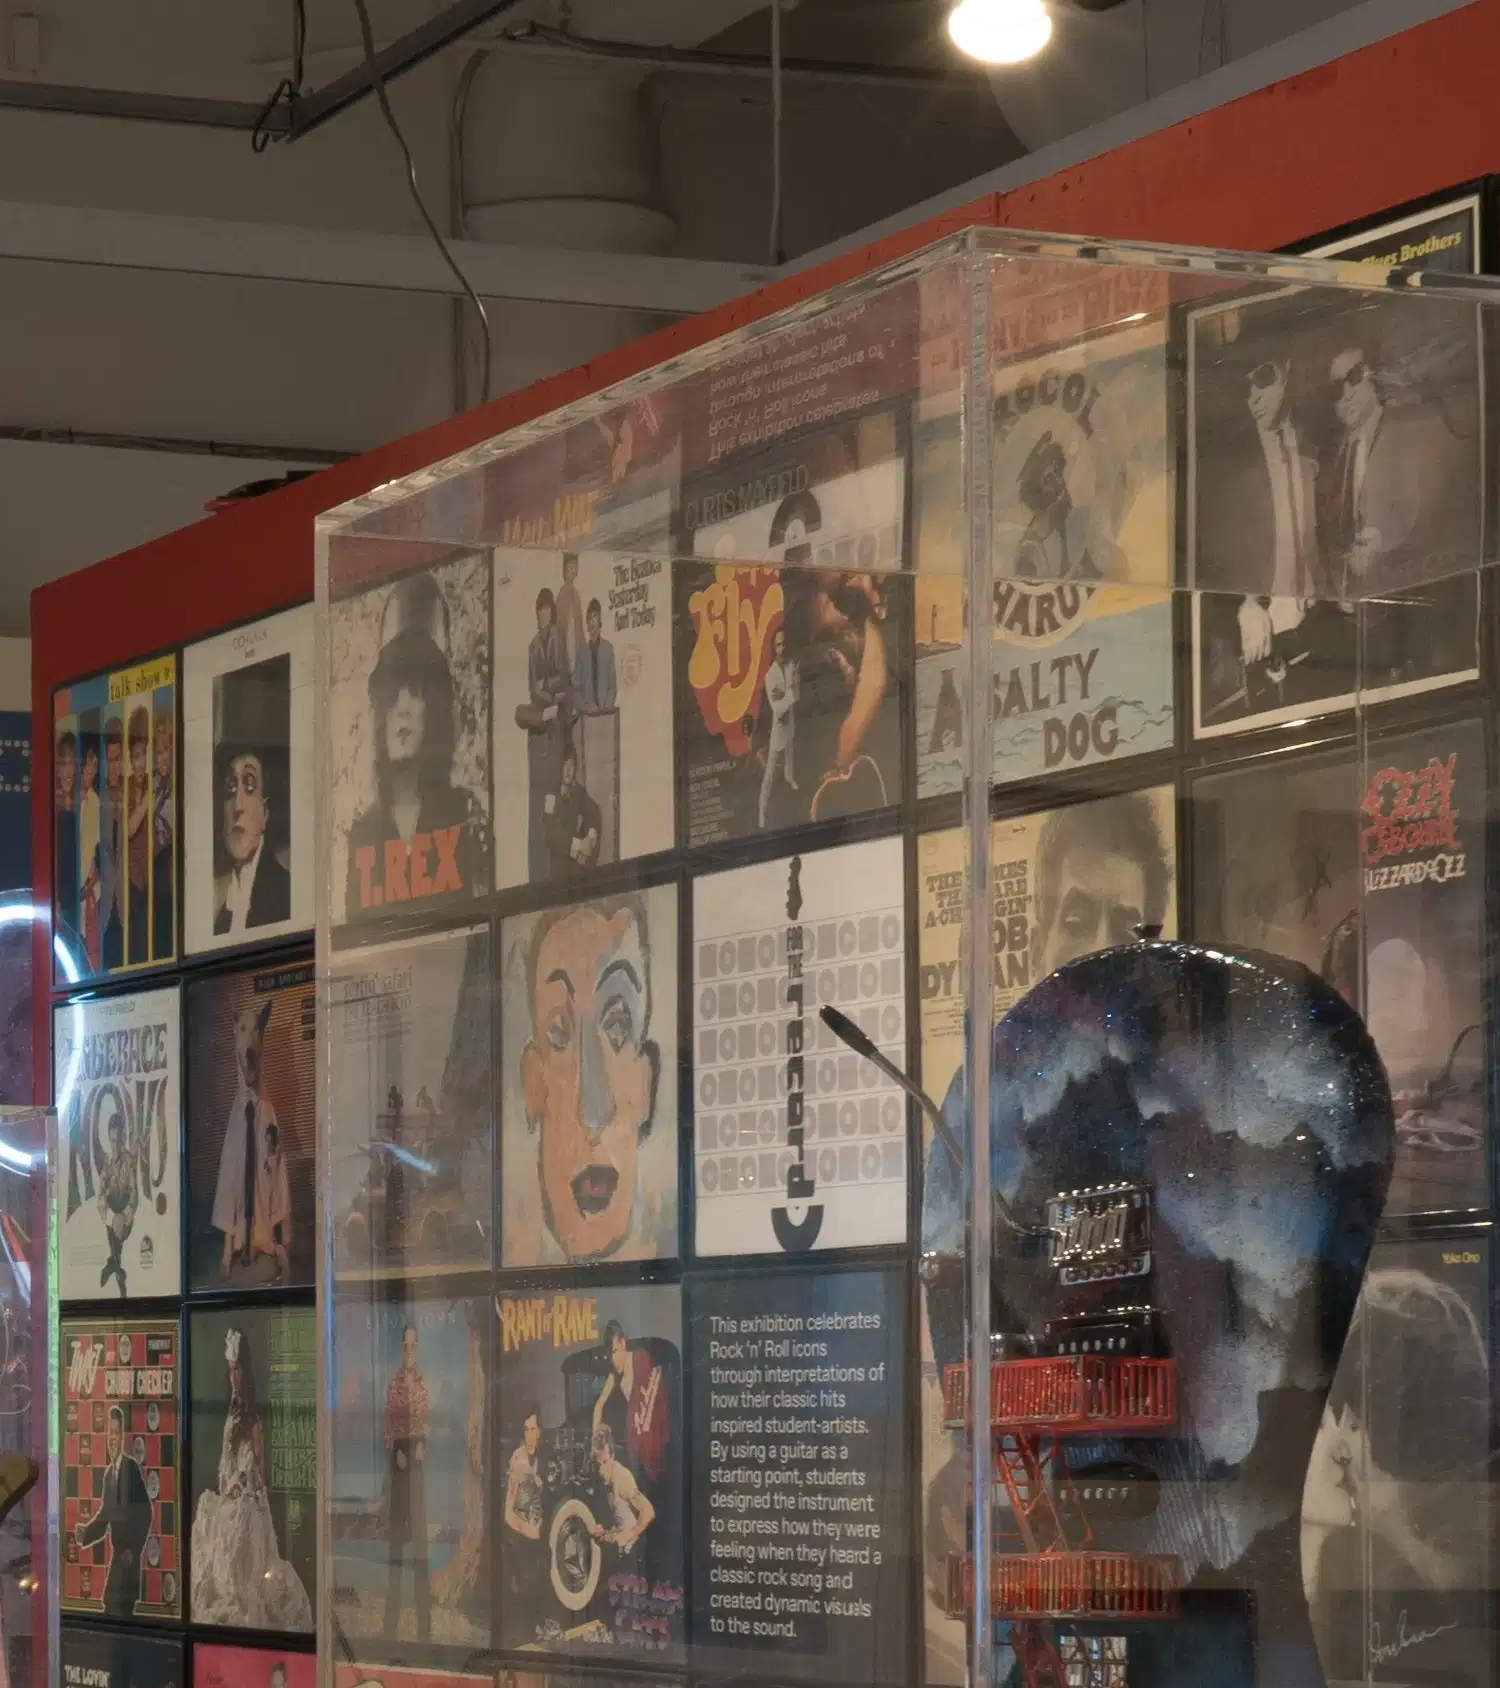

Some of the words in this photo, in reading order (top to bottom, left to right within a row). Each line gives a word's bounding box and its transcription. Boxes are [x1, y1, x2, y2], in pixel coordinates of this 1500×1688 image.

[1400, 231, 1463, 265] Brothers
[688, 581, 784, 723] Fly
[110, 678, 131, 700] talk
[136, 669, 160, 693] show
[1043, 708, 1118, 768] DOG
[355, 825, 462, 909] T.REX
[710, 1316, 736, 1333] This
[740, 1315, 803, 1333] exhibition
[807, 1313, 880, 1331] celebrates
[710, 1342, 744, 1359] Rock
[764, 1341, 789, 1357] Roll
[792, 1341, 828, 1357] icons
[711, 1367, 762, 1387] through
[765, 1364, 865, 1385] interpretations
[868, 1363, 885, 1381] of
[711, 1391, 738, 1408] how
[741, 1391, 772, 1408] their
[773, 1391, 817, 1408] classic
[820, 1391, 846, 1408] hits
[711, 1416, 762, 1437] inspired
[765, 1416, 869, 1434] student-artists.
[711, 1442, 729, 1461] By
[731, 1443, 766, 1462] using
[768, 1446, 778, 1459] a
[779, 1442, 819, 1463] guitar
[821, 1446, 836, 1460] as
[840, 1446, 848, 1460] a
[710, 1467, 762, 1487] starting
[764, 1468, 803, 1488] point,
[805, 1468, 866, 1486] students
[710, 1492, 771, 1513] designed
[773, 1493, 795, 1510] the
[798, 1493, 874, 1512] instrument
[710, 1517, 724, 1534] to
[727, 1520, 779, 1539] express
[781, 1517, 810, 1535] how
[812, 1518, 841, 1540] they
[844, 1523, 881, 1538] were
[710, 1541, 755, 1563] feeling
[758, 1544, 794, 1561] when
[796, 1545, 827, 1566] they
[829, 1545, 870, 1564] heard
[873, 1551, 882, 1565] a
[710, 1567, 755, 1585] classic
[758, 1569, 788, 1586] rock
[789, 1572, 822, 1593] song
[825, 1571, 852, 1589] and
[710, 1593, 762, 1611] created
[764, 1595, 821, 1617] dynamic
[824, 1599, 871, 1617] visuals
[710, 1616, 724, 1632] to
[728, 1617, 751, 1634] the
[753, 1619, 797, 1638] sound.
[64, 1665, 81, 1683] THE
